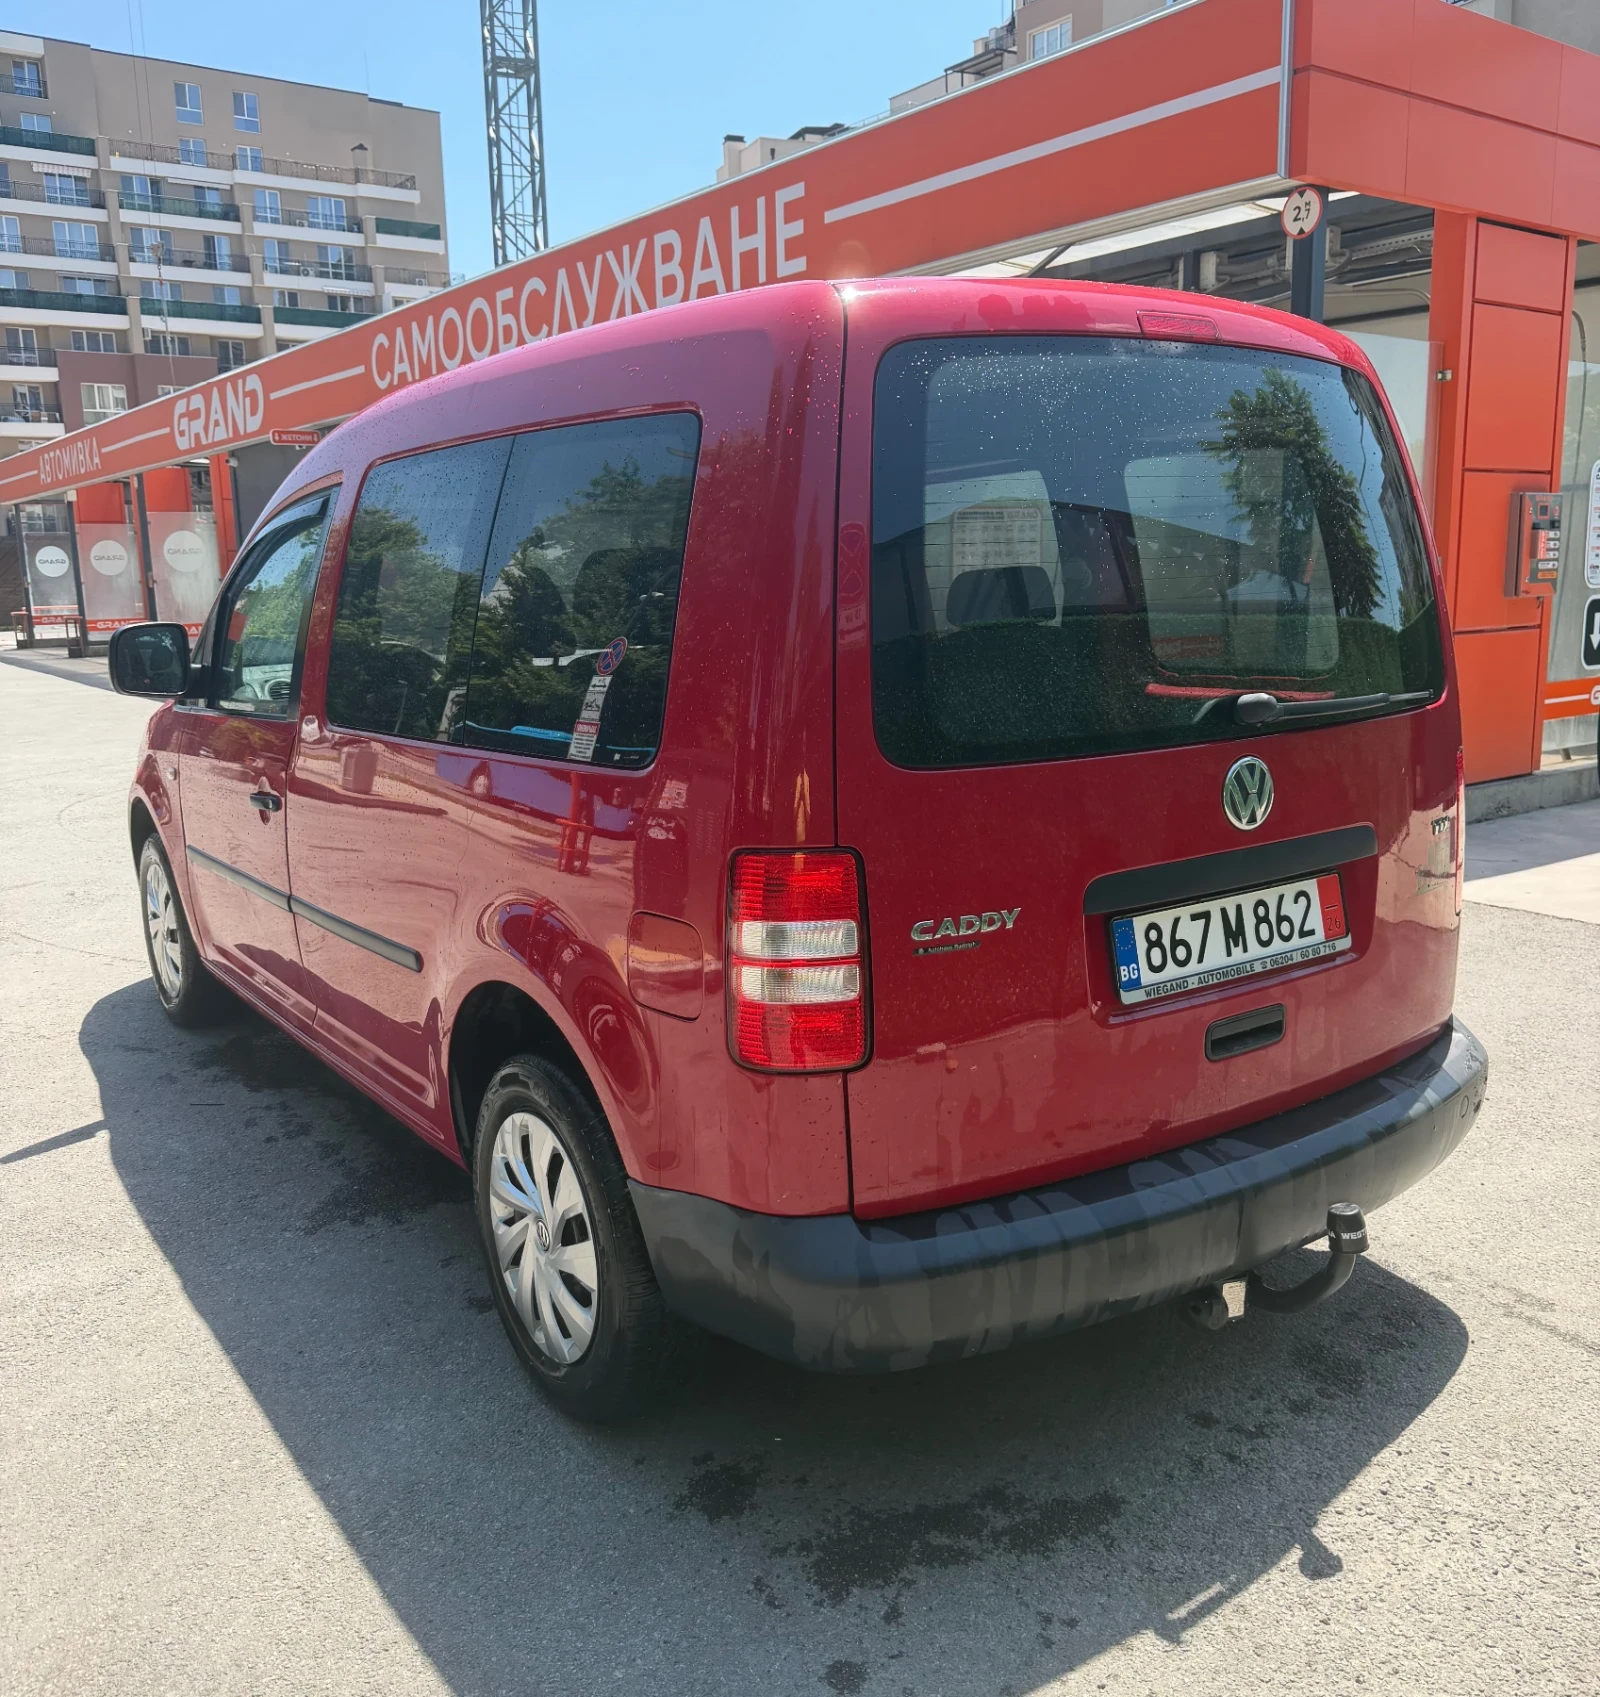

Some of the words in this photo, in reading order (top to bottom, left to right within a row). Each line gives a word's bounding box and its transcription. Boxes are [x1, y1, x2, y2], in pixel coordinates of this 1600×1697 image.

[1292, 206, 1310, 222] 2,7
[370, 181, 807, 390] САМООБСЛУЖВАНЕ
[173, 373, 264, 451] GRAND
[39, 436, 101, 485] АВТОМИВКА
[41, 616, 64, 624] GRA
[96, 620, 130, 629] GRAN
[910, 907, 1022, 941] CADDY
[1144, 910, 1211, 973] 867
[1220, 903, 1248, 958] M
[1253, 890, 1316, 948] 862
[1120, 962, 1139, 982] BG
[1144, 979, 1189, 998] WIEGAND
[1197, 963, 1255, 985] AUTOMOBILE
[1269, 953, 1294, 967] 06204
[1300, 949, 1310, 959] 60
[1311, 946, 1321, 957] 80
[1323, 942, 1337, 953] 716
